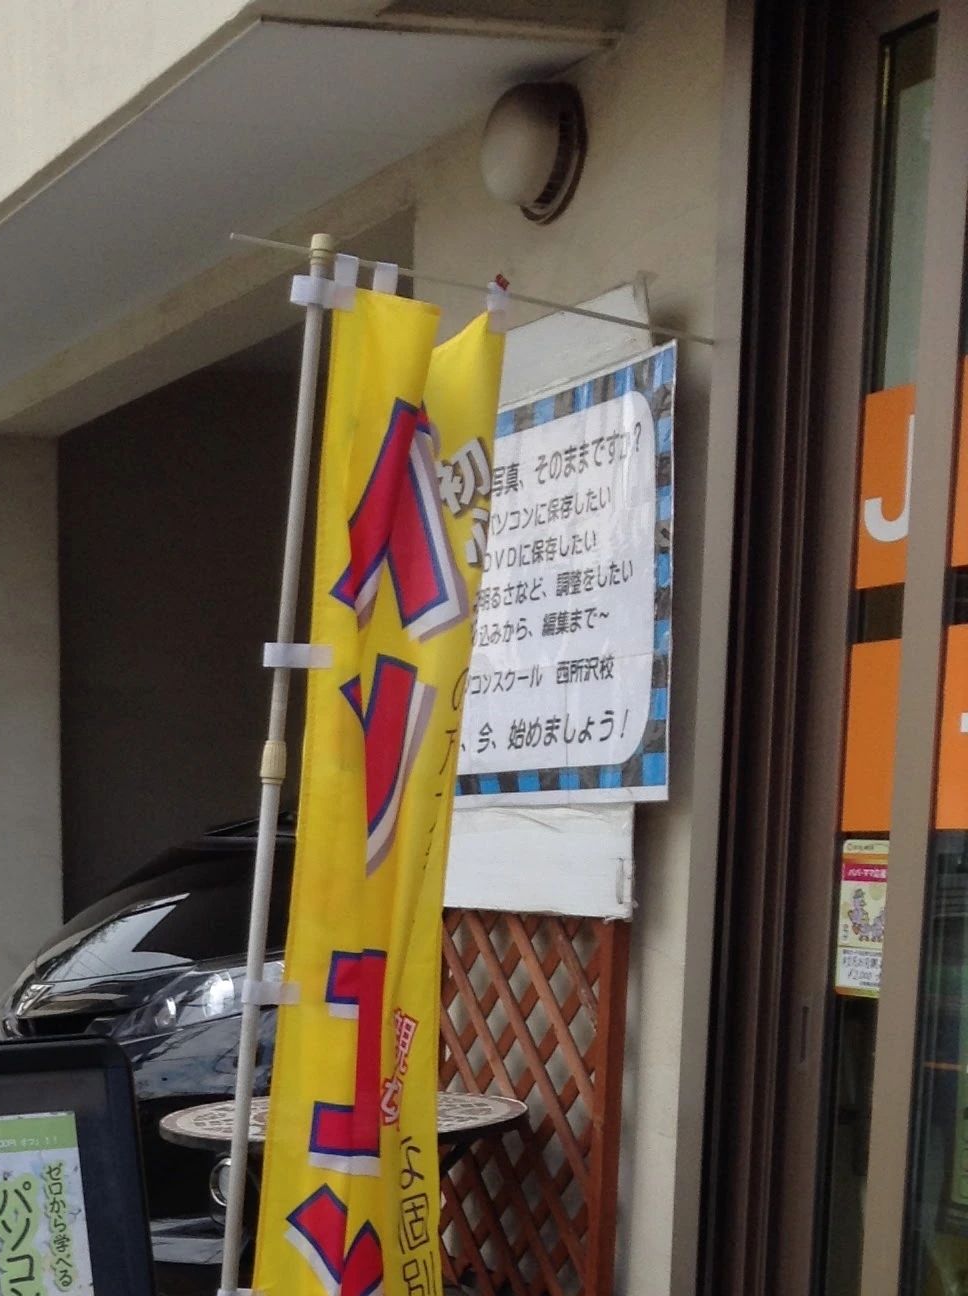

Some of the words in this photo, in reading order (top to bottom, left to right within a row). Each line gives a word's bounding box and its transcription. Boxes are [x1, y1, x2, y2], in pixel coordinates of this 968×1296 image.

[556, 655, 614, 685] 西所沢校
[46, 1162, 73, 1287] ゼロから学べる
